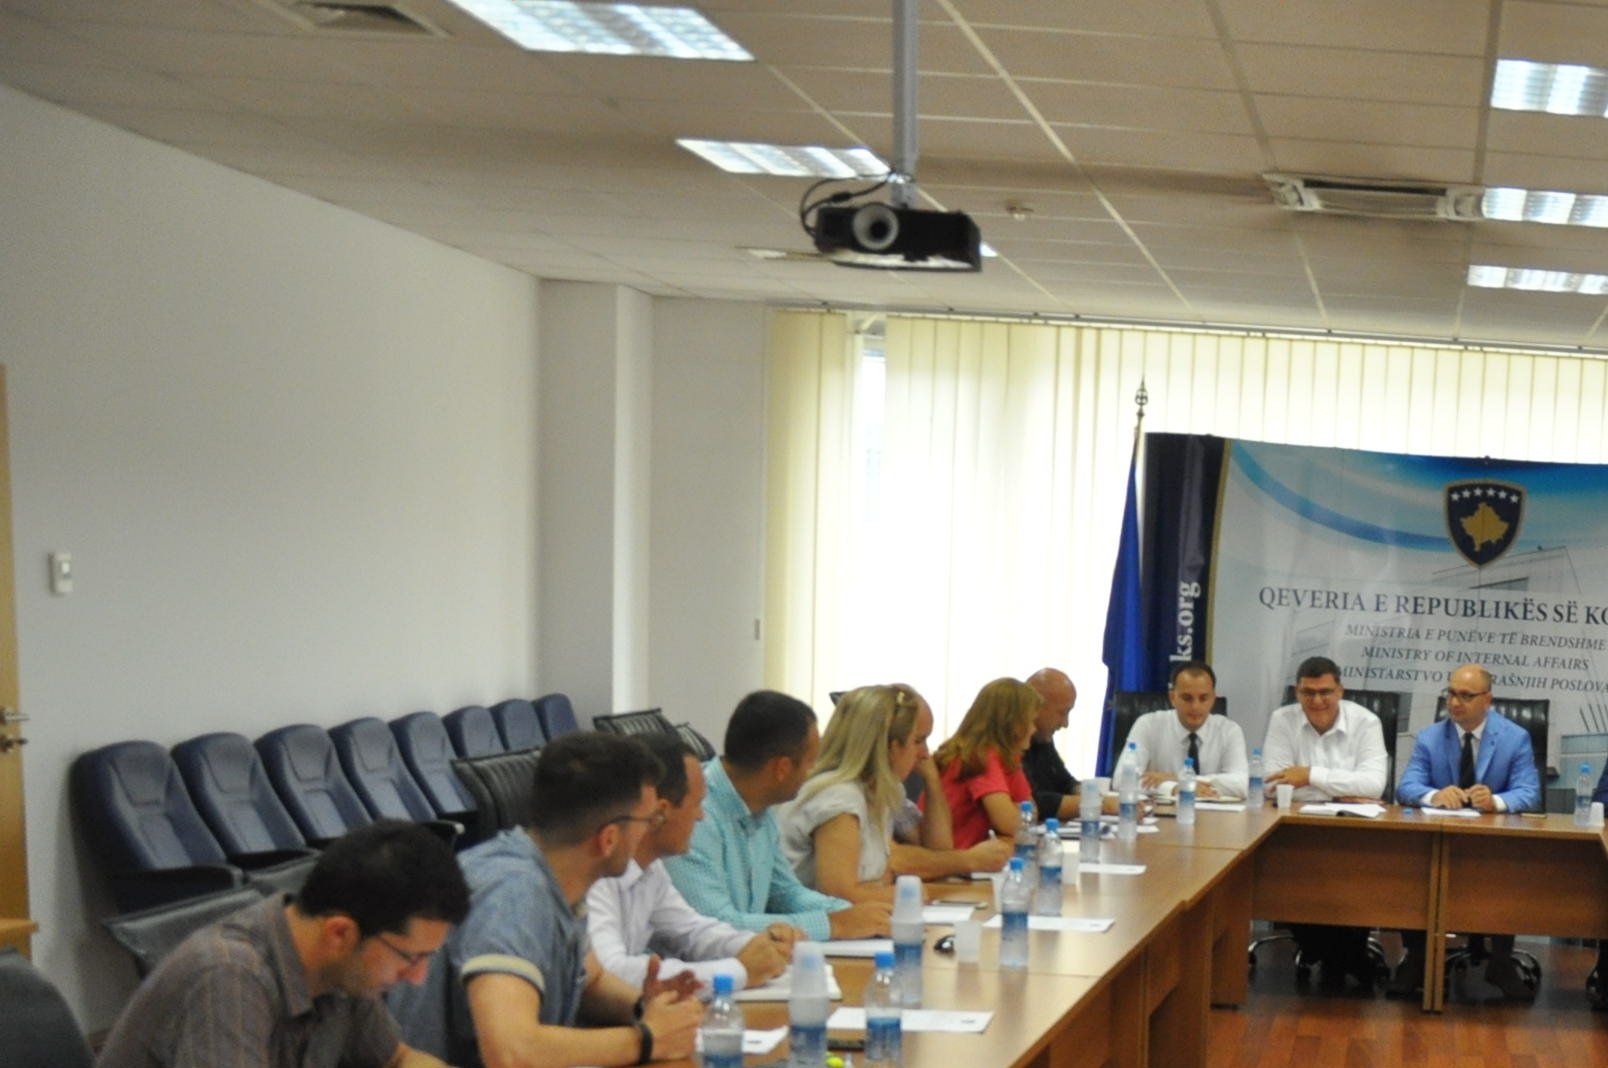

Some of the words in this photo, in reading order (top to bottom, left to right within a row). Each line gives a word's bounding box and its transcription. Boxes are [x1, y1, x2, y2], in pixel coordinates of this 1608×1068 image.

[1259, 586, 1366, 611] QEVERIA
[1374, 593, 1388, 613] E
[1395, 595, 1548, 622] REPUBLIKËS
[1552, 600, 1579, 624] SË
[1345, 624, 1422, 640] MINISTRIA
[1424, 628, 1435, 641] E
[1520, 635, 1607, 651] BRENDSHME
[1361, 645, 1433, 661] MINISTRY
[1434, 649, 1456, 663] OF
[1456, 651, 1530, 667] INTERNAL
[1533, 656, 1590, 671] AFFAIRS
